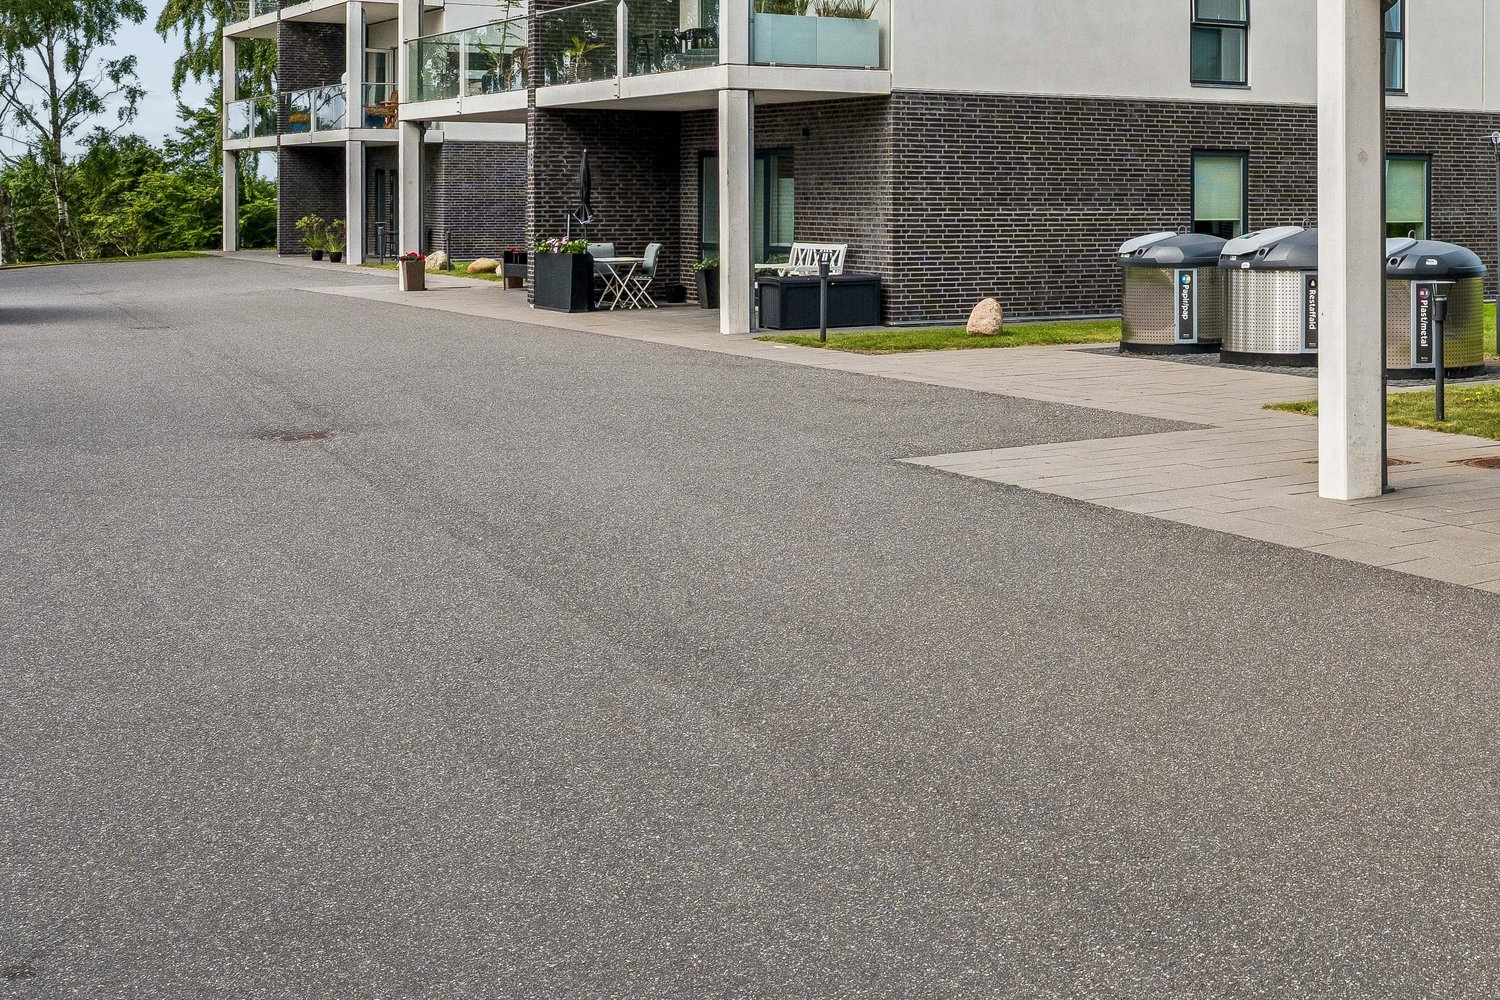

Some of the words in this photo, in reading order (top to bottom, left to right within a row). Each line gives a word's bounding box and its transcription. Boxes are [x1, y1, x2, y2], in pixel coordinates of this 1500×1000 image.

[1181, 284, 1190, 320] Papir/pap
[1308, 289, 1317, 330] Restaffald
[1420, 300, 1429, 347] Plast/metal
